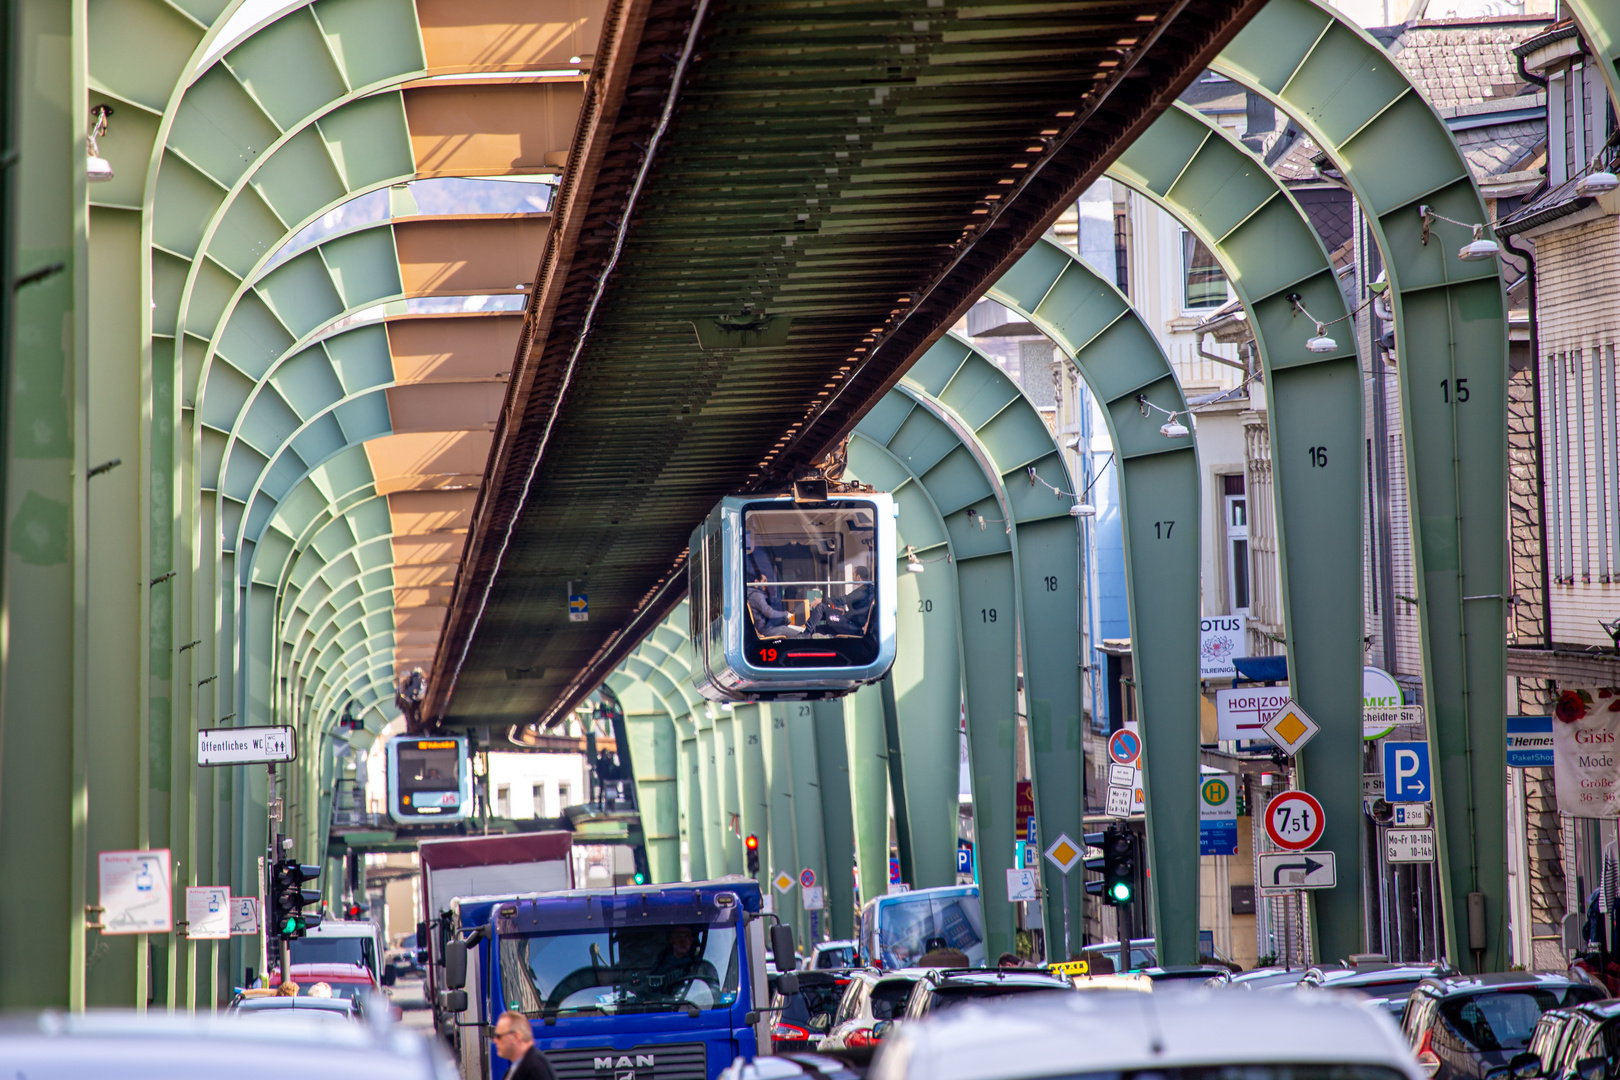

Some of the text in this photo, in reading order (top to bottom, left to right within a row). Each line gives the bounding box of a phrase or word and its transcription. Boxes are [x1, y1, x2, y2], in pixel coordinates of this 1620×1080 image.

[1440, 378, 1470, 403] 15
[1308, 446, 1328, 467] 16
[1154, 521, 1175, 539] 17
[1044, 576, 1058, 591] 18
[918, 599, 933, 612] 20
[981, 608, 997, 623] 19
[1200, 618, 1240, 631] OTUS
[759, 648, 777, 661] 19
[1201, 666, 1236, 674] TILREINIGU
[1228, 696, 1288, 709] HORIZON
[1363, 696, 1397, 711] MKE
[798, 705, 810, 716] 23
[1363, 712, 1398, 722] cheidter
[748, 735, 758, 745] 25
[1515, 736, 1554, 747] Hermes
[1575, 728, 1615, 744] Gisis
[201, 738, 263, 752] Öffentliches WC
[1579, 754, 1613, 767] Mode
[1395, 749, 1420, 794] P
[1580, 792, 1593, 802] 36
[1603, 791, 1616, 802] 56
[1389, 848, 1397, 857] Sa
[958, 852, 967, 870] P
[594, 1054, 654, 1069] MAN
